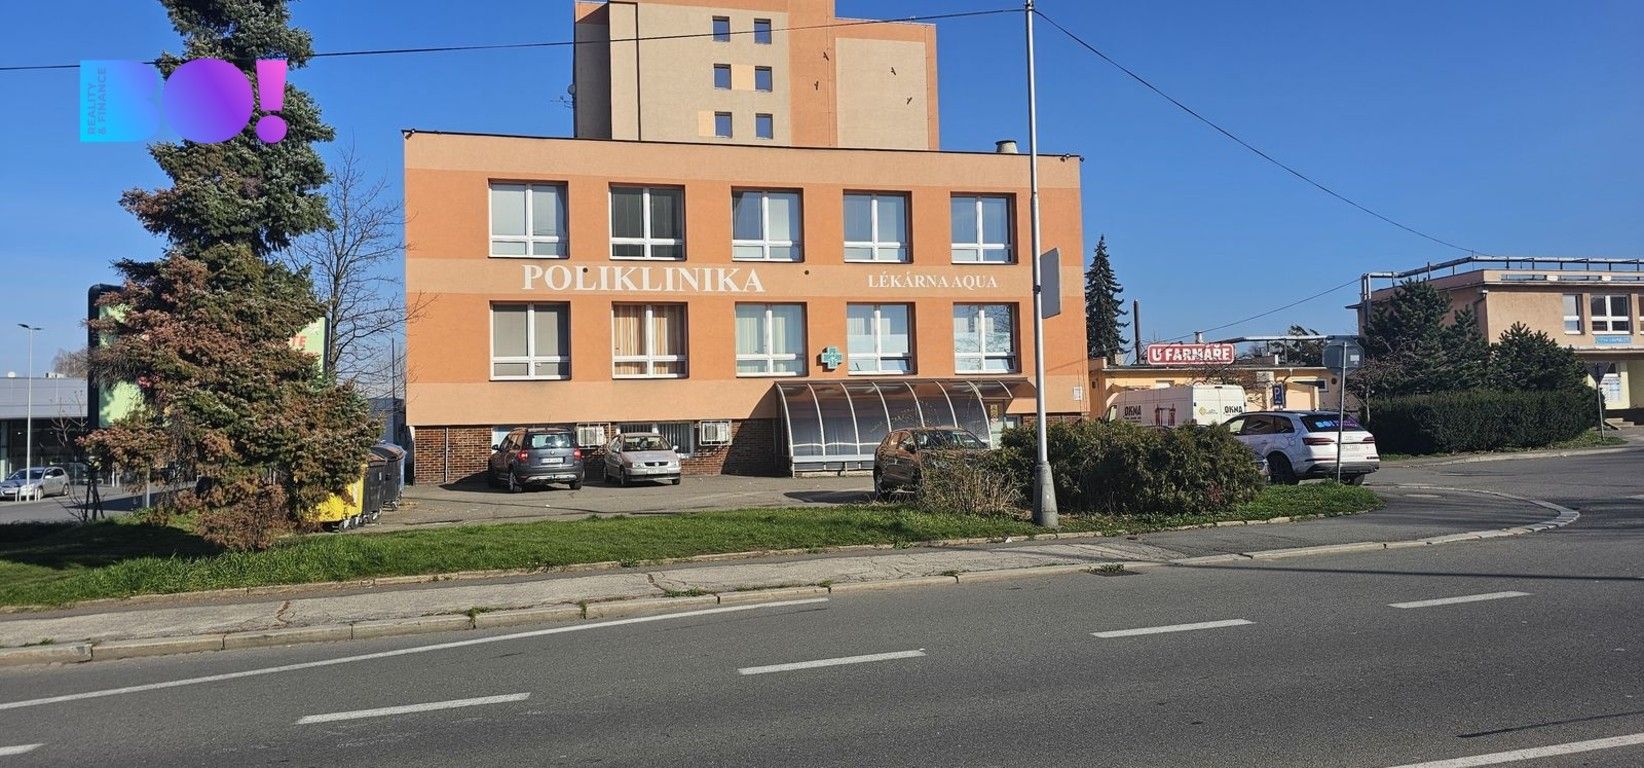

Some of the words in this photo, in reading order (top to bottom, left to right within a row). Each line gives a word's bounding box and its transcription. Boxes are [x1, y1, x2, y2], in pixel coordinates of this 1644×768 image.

[521, 264, 766, 293] POLIKLINIKA
[868, 271, 948, 288] LÉKÁRNA
[951, 275, 998, 290] AQUA
[1152, 348, 1162, 361] U
[1165, 344, 1230, 361] FARMÁŘE
[1124, 405, 1141, 416] OKNA
[1224, 405, 1243, 414] OKNA
